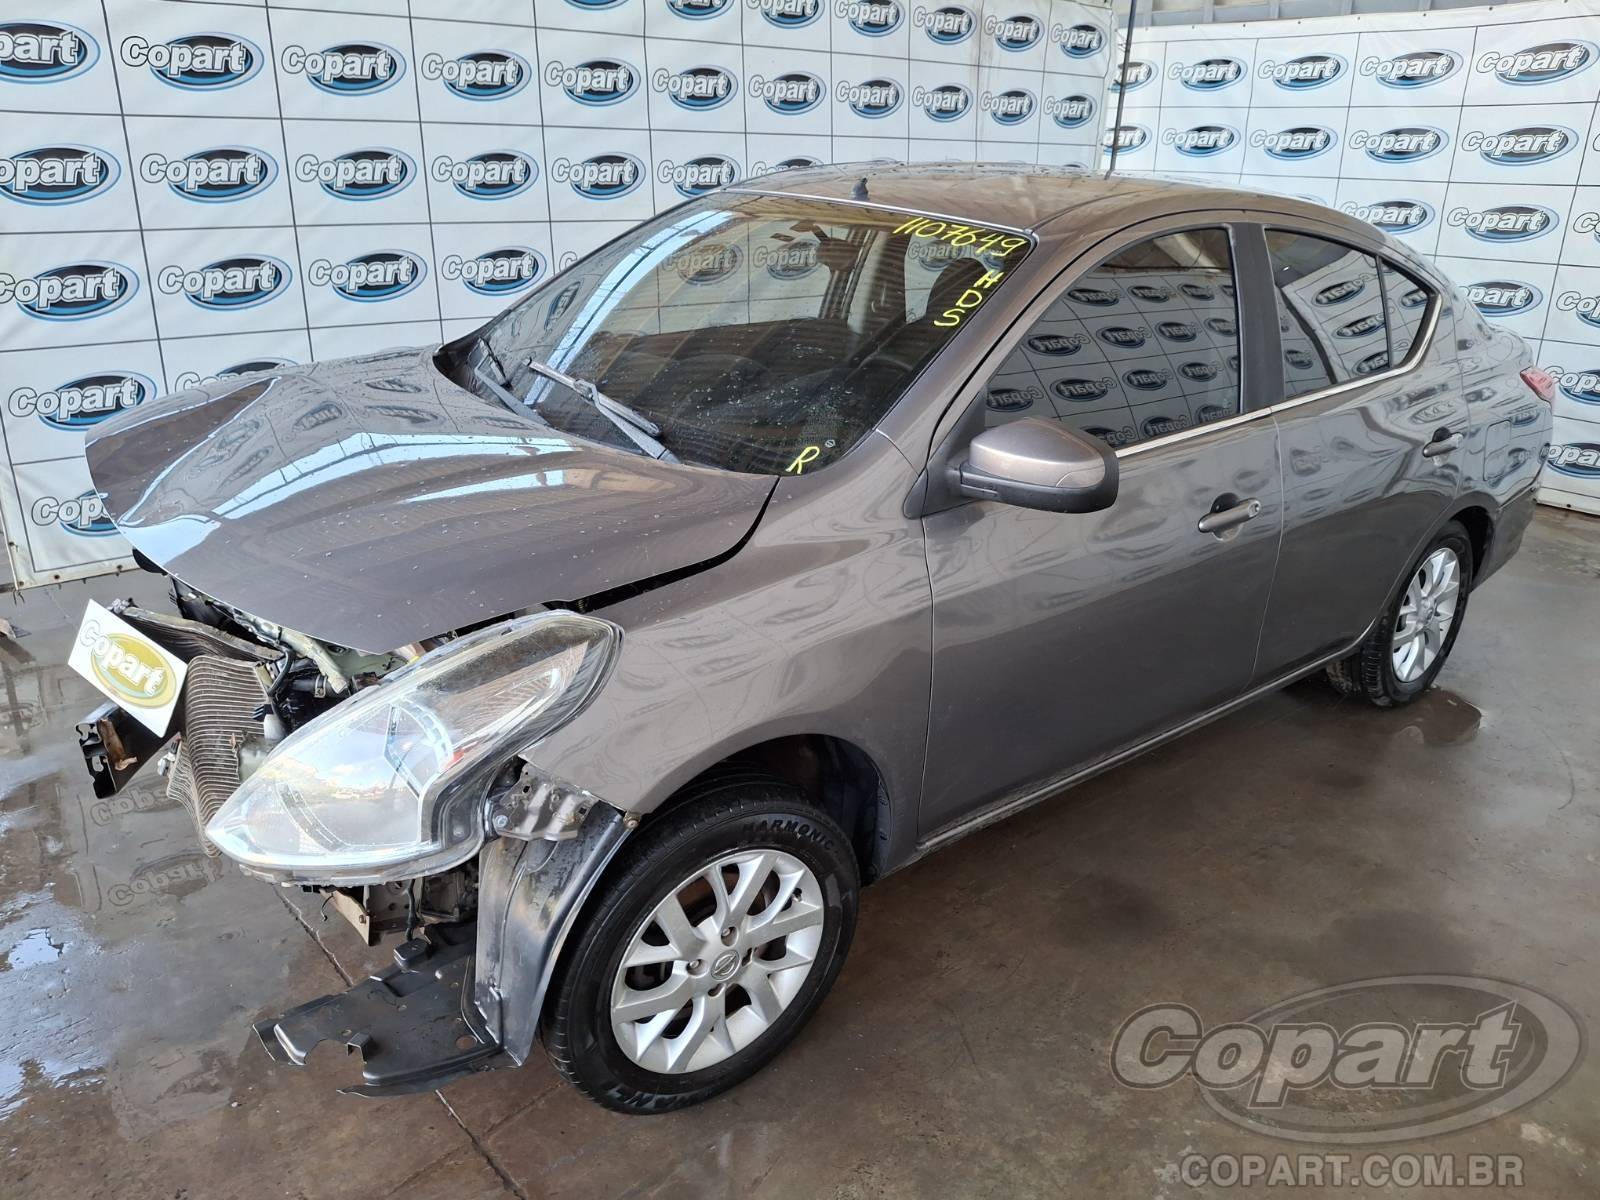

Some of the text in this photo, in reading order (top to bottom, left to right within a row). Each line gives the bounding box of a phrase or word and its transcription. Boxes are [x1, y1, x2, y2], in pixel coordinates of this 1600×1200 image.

[834, 0, 898, 25] Copart
[913, 6, 971, 34] Copart
[985, 15, 1038, 42] Copart
[1051, 23, 1100, 49] Copart
[120, 36, 248, 76] Copart
[281, 41, 392, 81] Copart
[422, 53, 518, 88] Copart
[1258, 57, 1336, 84] Copart
[1359, 54, 1450, 84] Copart
[1476, 45, 1585, 78] Copart
[545, 61, 629, 96] Copart
[652, 68, 729, 100] Copart
[1168, 62, 1238, 82] Copart
[749, 75, 817, 104] Copart
[836, 81, 898, 109] Copart
[912, 87, 966, 110] Copart
[980, 91, 1031, 115] Copart
[1044, 96, 1091, 117] Copart
[1162, 128, 1232, 150] Copart
[1250, 128, 1329, 157] Copart
[1349, 130, 1437, 160] Copart
[1462, 130, 1565, 158] Copart
[0, 152, 101, 192] opart
[140, 154, 262, 190] Copart
[295, 154, 402, 189] Copart
[431, 155, 525, 188] Copart
[552, 157, 634, 190] Copart
[657, 159, 730, 190] Copart
[1447, 207, 1545, 233] Copart
[892, 217, 1029, 256] 1107649
[442, 252, 534, 287] Copart
[753, 246, 816, 267] Copart
[158, 259, 278, 296] Copart
[308, 256, 412, 293] Copart
[1459, 286, 1530, 307] part
[8, 377, 138, 421] Copart
[785, 446, 820, 474] R
[80, 619, 166, 697] Copart
